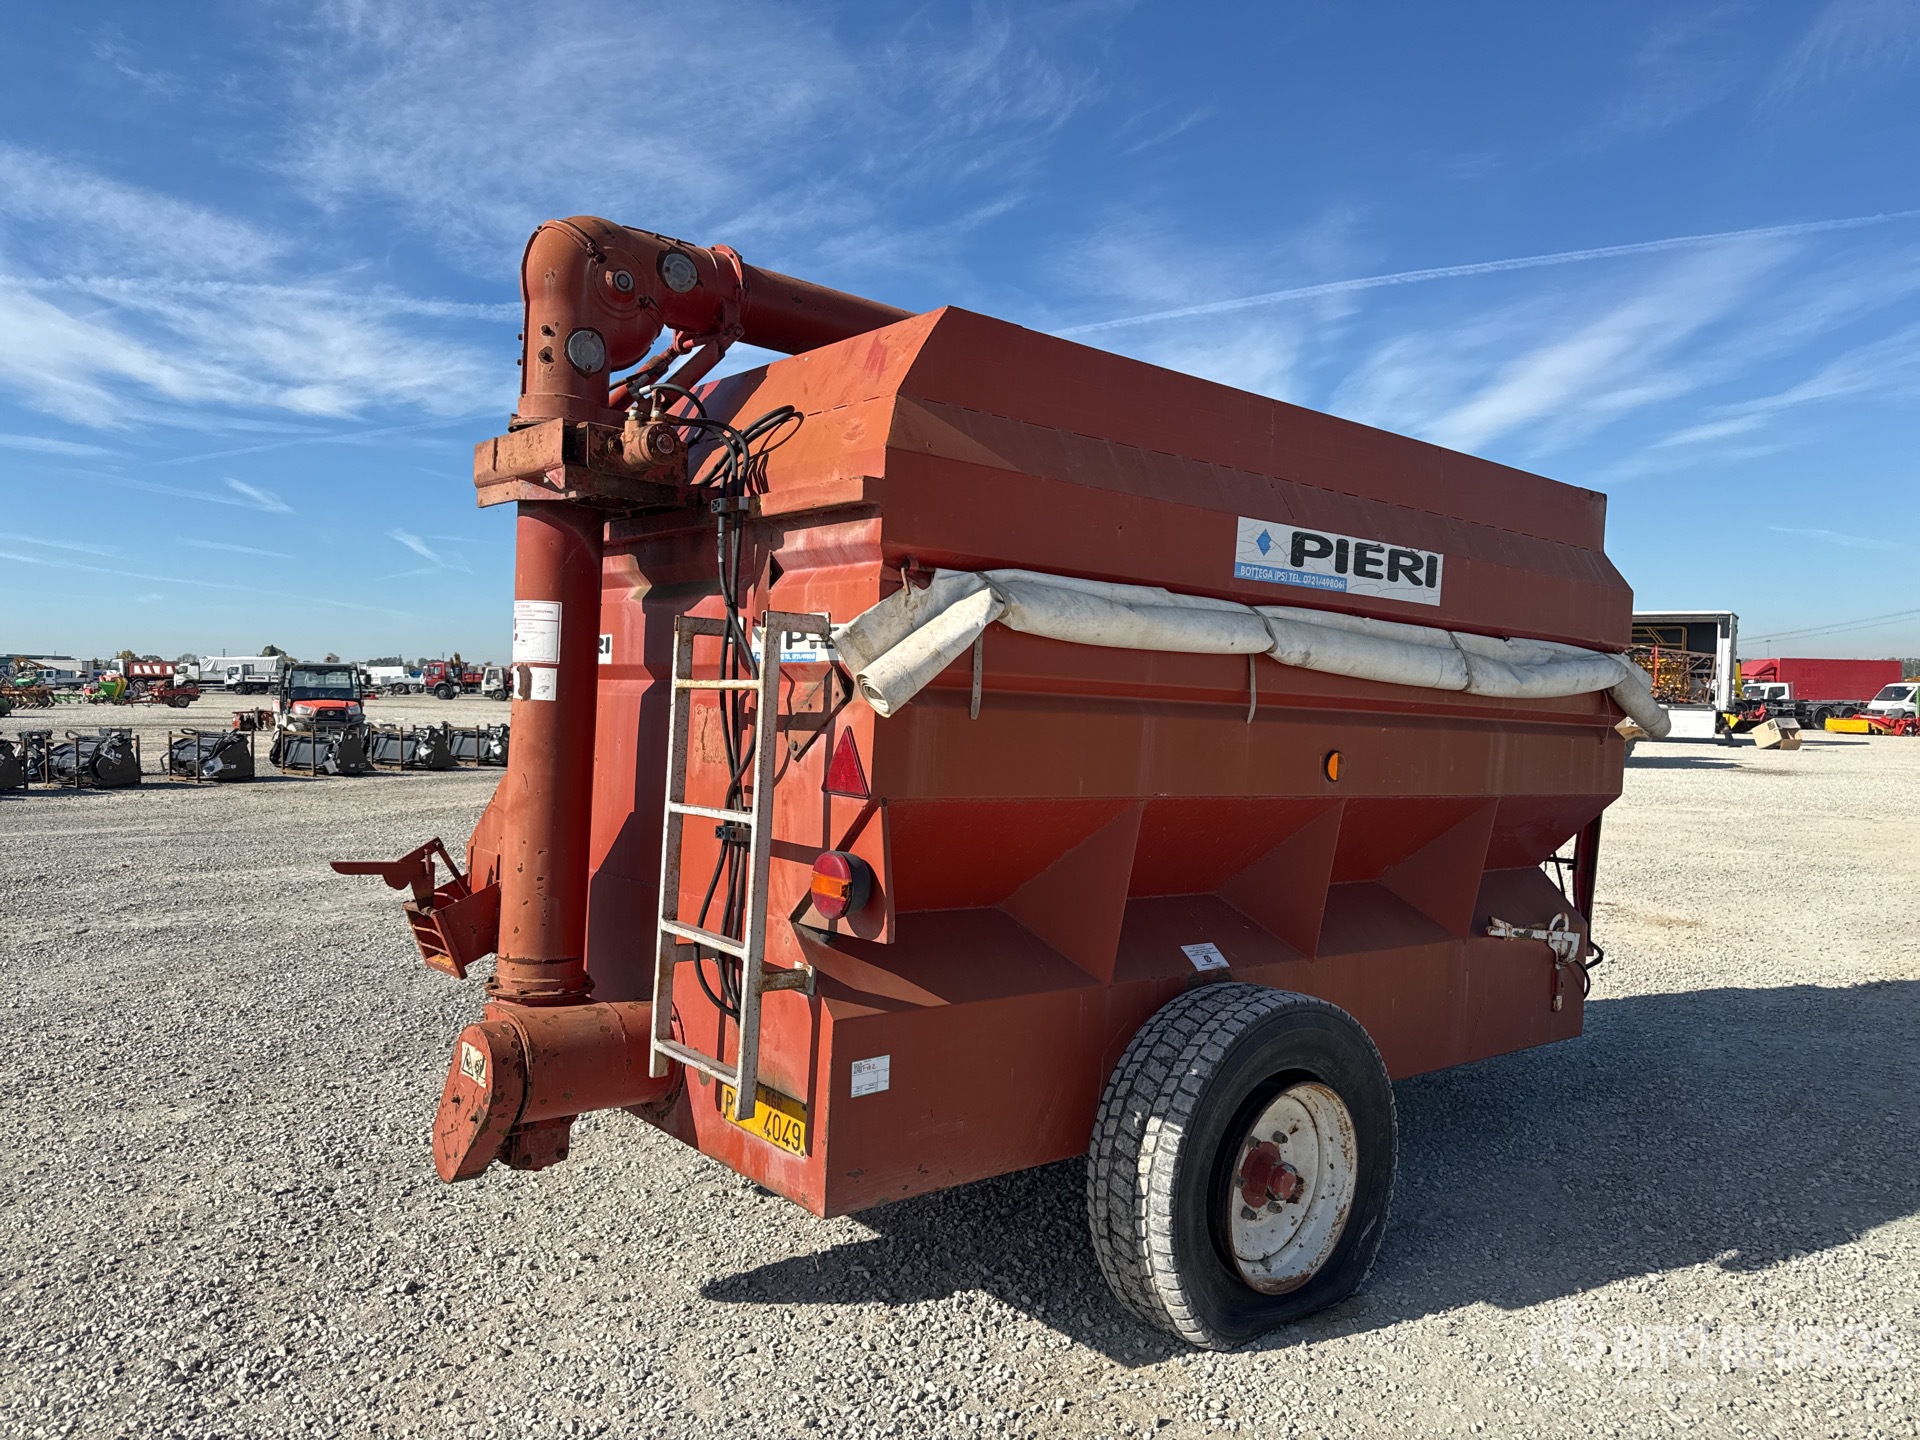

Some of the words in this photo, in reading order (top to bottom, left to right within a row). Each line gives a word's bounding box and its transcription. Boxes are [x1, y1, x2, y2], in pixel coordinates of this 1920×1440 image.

[1240, 566, 1273, 579] BOTTEGA
[1274, 570, 1287, 582] (PS)
[1303, 575, 1345, 589] 0721/498061
[1290, 531, 1438, 588] PIERI
[763, 1109, 801, 1152] 4049
